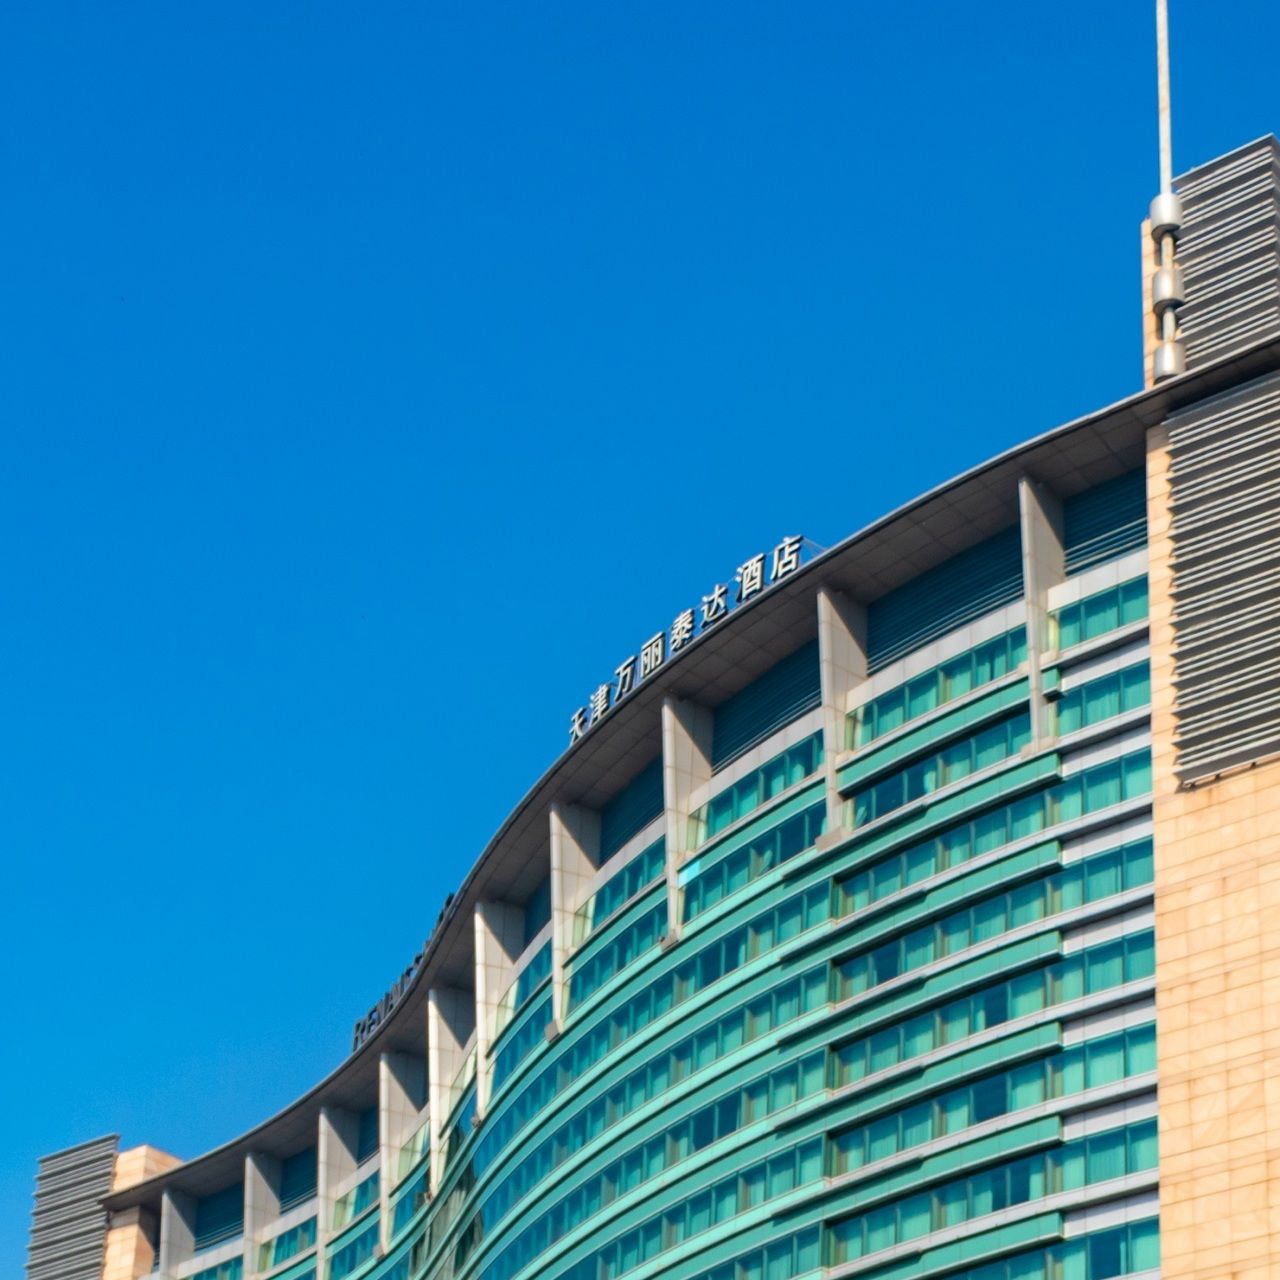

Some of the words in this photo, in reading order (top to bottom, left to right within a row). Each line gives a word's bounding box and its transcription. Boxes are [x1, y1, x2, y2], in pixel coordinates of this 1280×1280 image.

[569, 534, 804, 743] 天津万丽泰达酒店
